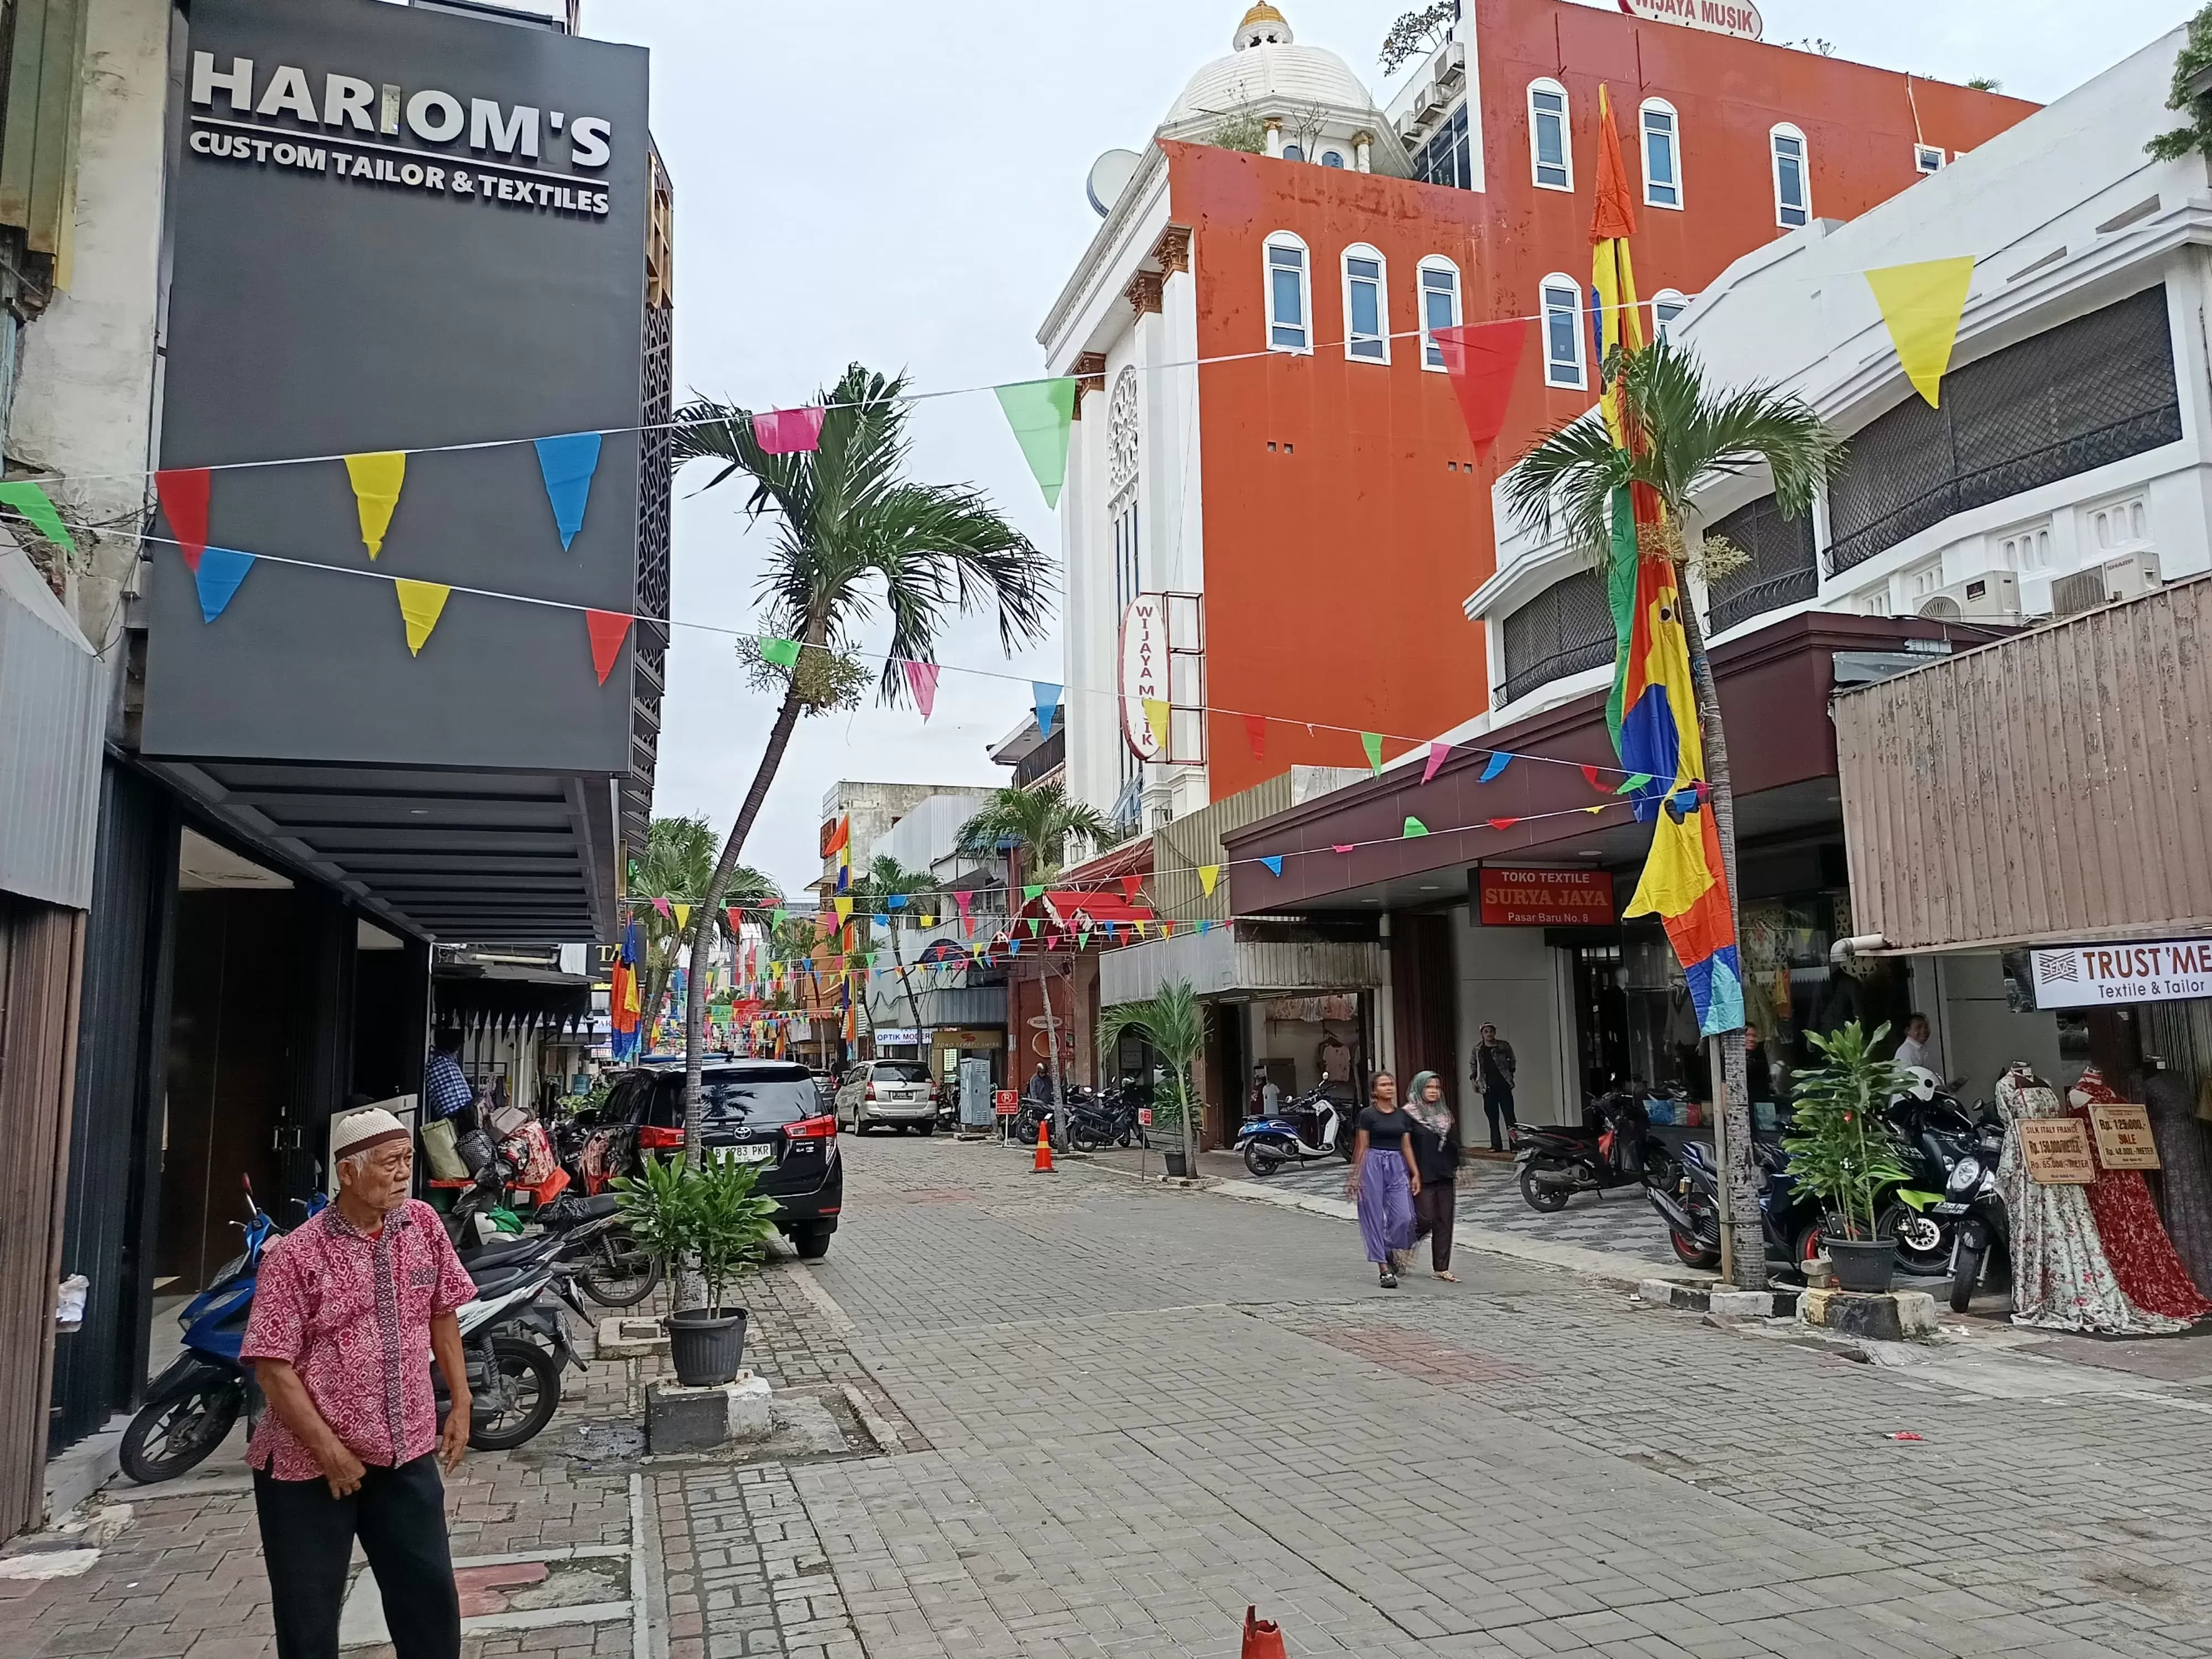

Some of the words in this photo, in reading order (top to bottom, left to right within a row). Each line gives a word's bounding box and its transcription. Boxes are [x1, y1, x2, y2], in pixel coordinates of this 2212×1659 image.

[1702, 1, 1754, 33] MUSIK
[191, 51, 611, 166] HARIOM'S
[190, 130, 326, 171] CUSTOM
[332, 152, 445, 190] TAILOR
[452, 171, 474, 193] &
[478, 174, 609, 215] TEXTILES
[2106, 559, 2133, 571] SHARP
[1136, 606, 1153, 678] WIJAYA
[1139, 685, 1154, 746] MIK
[1502, 872, 1536, 883] TOKO
[1540, 873, 1590, 884] TEXTILE
[1485, 888, 1553, 905] SURYA
[1558, 890, 1608, 906] JAYA
[1508, 912, 1536, 922] Pasar
[1538, 914, 1561, 922] Baru
[1564, 914, 1580, 922] No.
[1583, 914, 1589, 922] 8
[2098, 984, 2146, 998] Textile
[2151, 983, 2161, 995] &
[2164, 980, 2204, 994] Tailor
[2099, 1119, 2112, 1131] Rp.
[2028, 1140, 2039, 1155] Rp.
[2118, 1134, 2137, 1145] SALE
[716, 1149, 721, 1157] B
[752, 1145, 769, 1155] PKR
